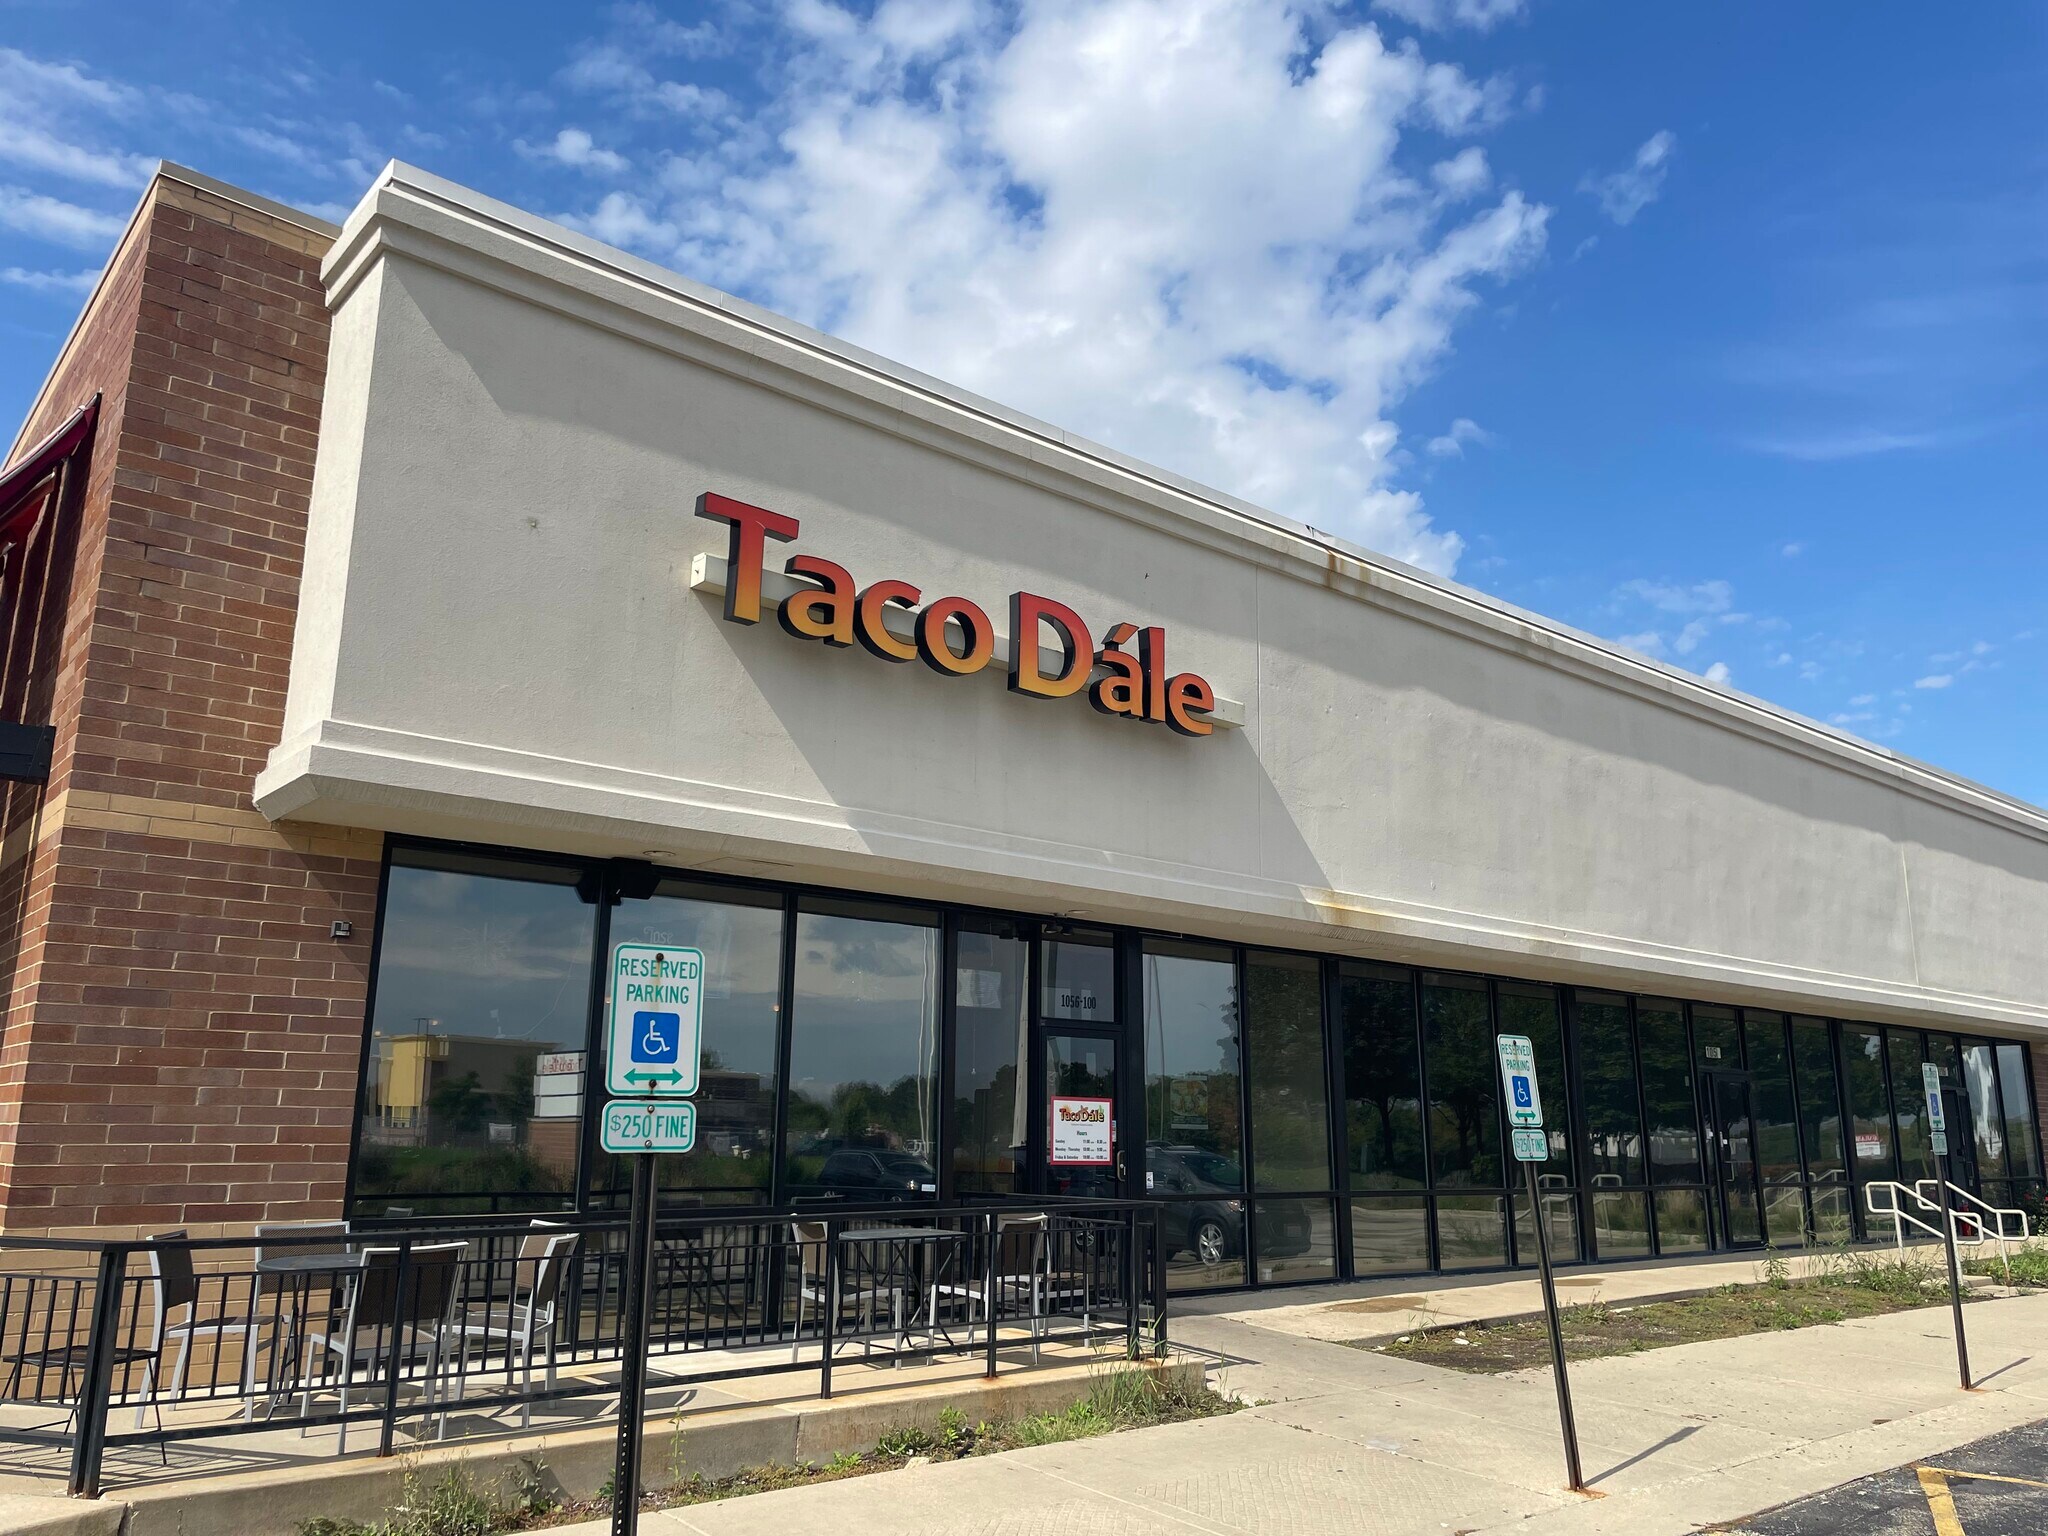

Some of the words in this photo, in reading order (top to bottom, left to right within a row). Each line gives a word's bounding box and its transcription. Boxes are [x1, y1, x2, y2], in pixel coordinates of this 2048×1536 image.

[695, 491, 994, 677] Taco
[1007, 590, 1214, 738] Dále
[619, 958, 698, 980] RESERVED
[626, 983, 689, 1005] PARKING
[1061, 994, 1097, 1009] 1056-100
[1500, 1043, 1531, 1057] RESERVED
[1505, 1058, 1530, 1072] PARKING
[1059, 1108, 1080, 1121] Taco
[1080, 1109, 1104, 1122] Dále
[610, 1115, 650, 1138] $250
[655, 1115, 689, 1138] FINE
